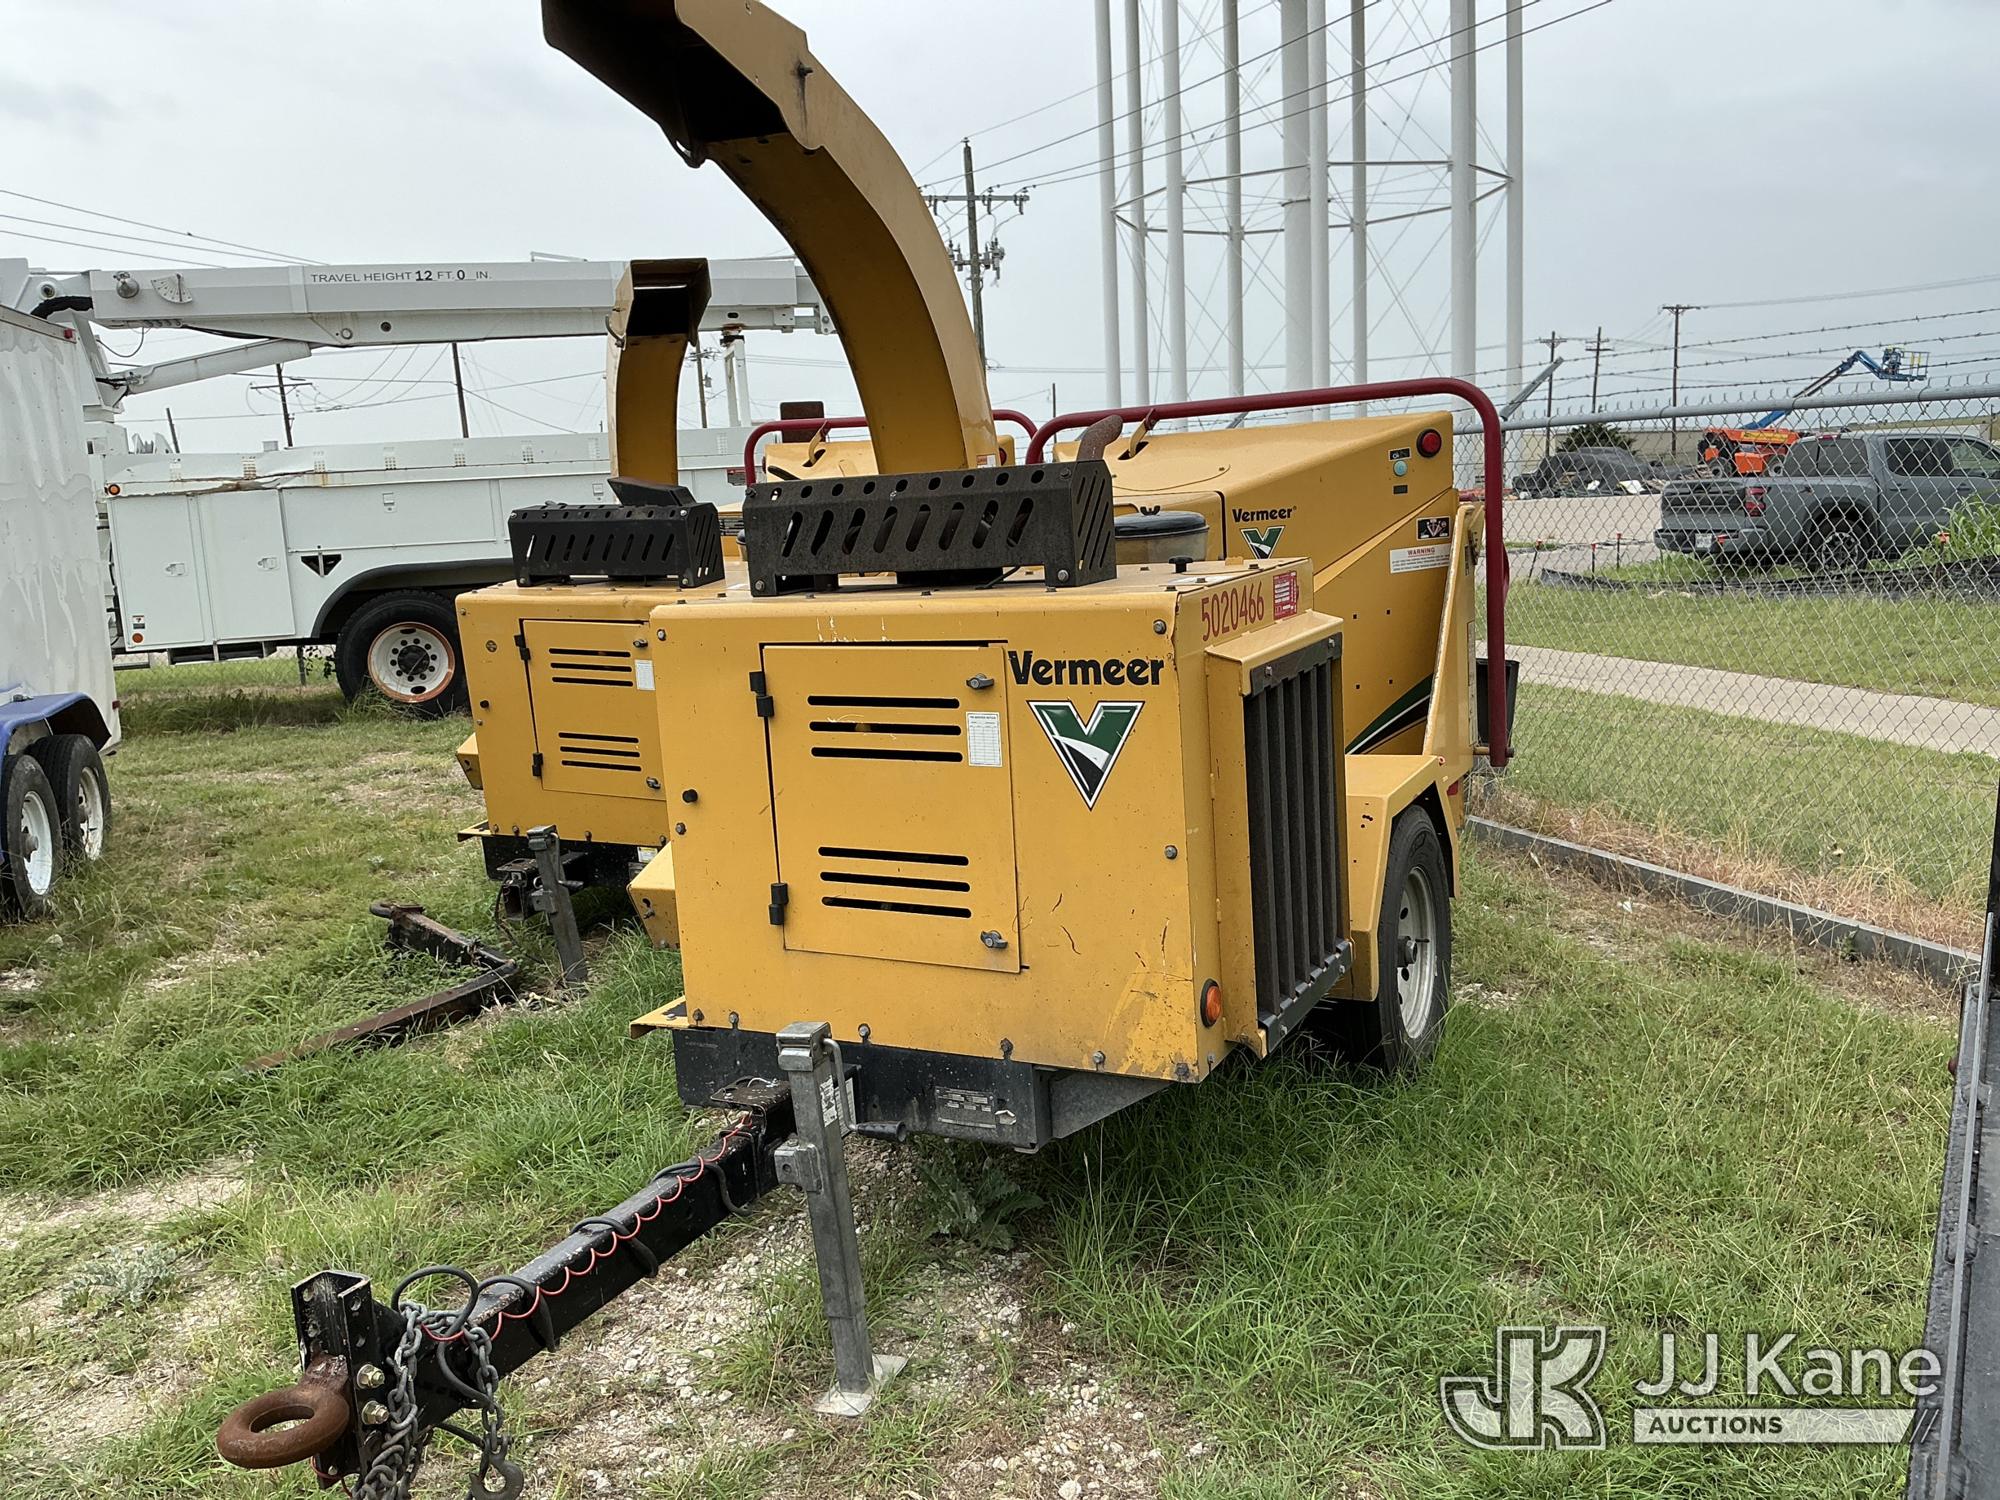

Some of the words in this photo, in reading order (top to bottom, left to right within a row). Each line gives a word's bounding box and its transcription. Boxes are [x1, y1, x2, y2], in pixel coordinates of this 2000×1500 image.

[311, 273, 361, 283] TRAVEL
[363, 271, 412, 281] HEIGHT
[415, 270, 433, 281] 12
[457, 269, 465, 281] 0
[1407, 547, 1435, 555] WARNING
[1201, 580, 1265, 642] 5020466
[1008, 650, 1164, 686] Vermeer
